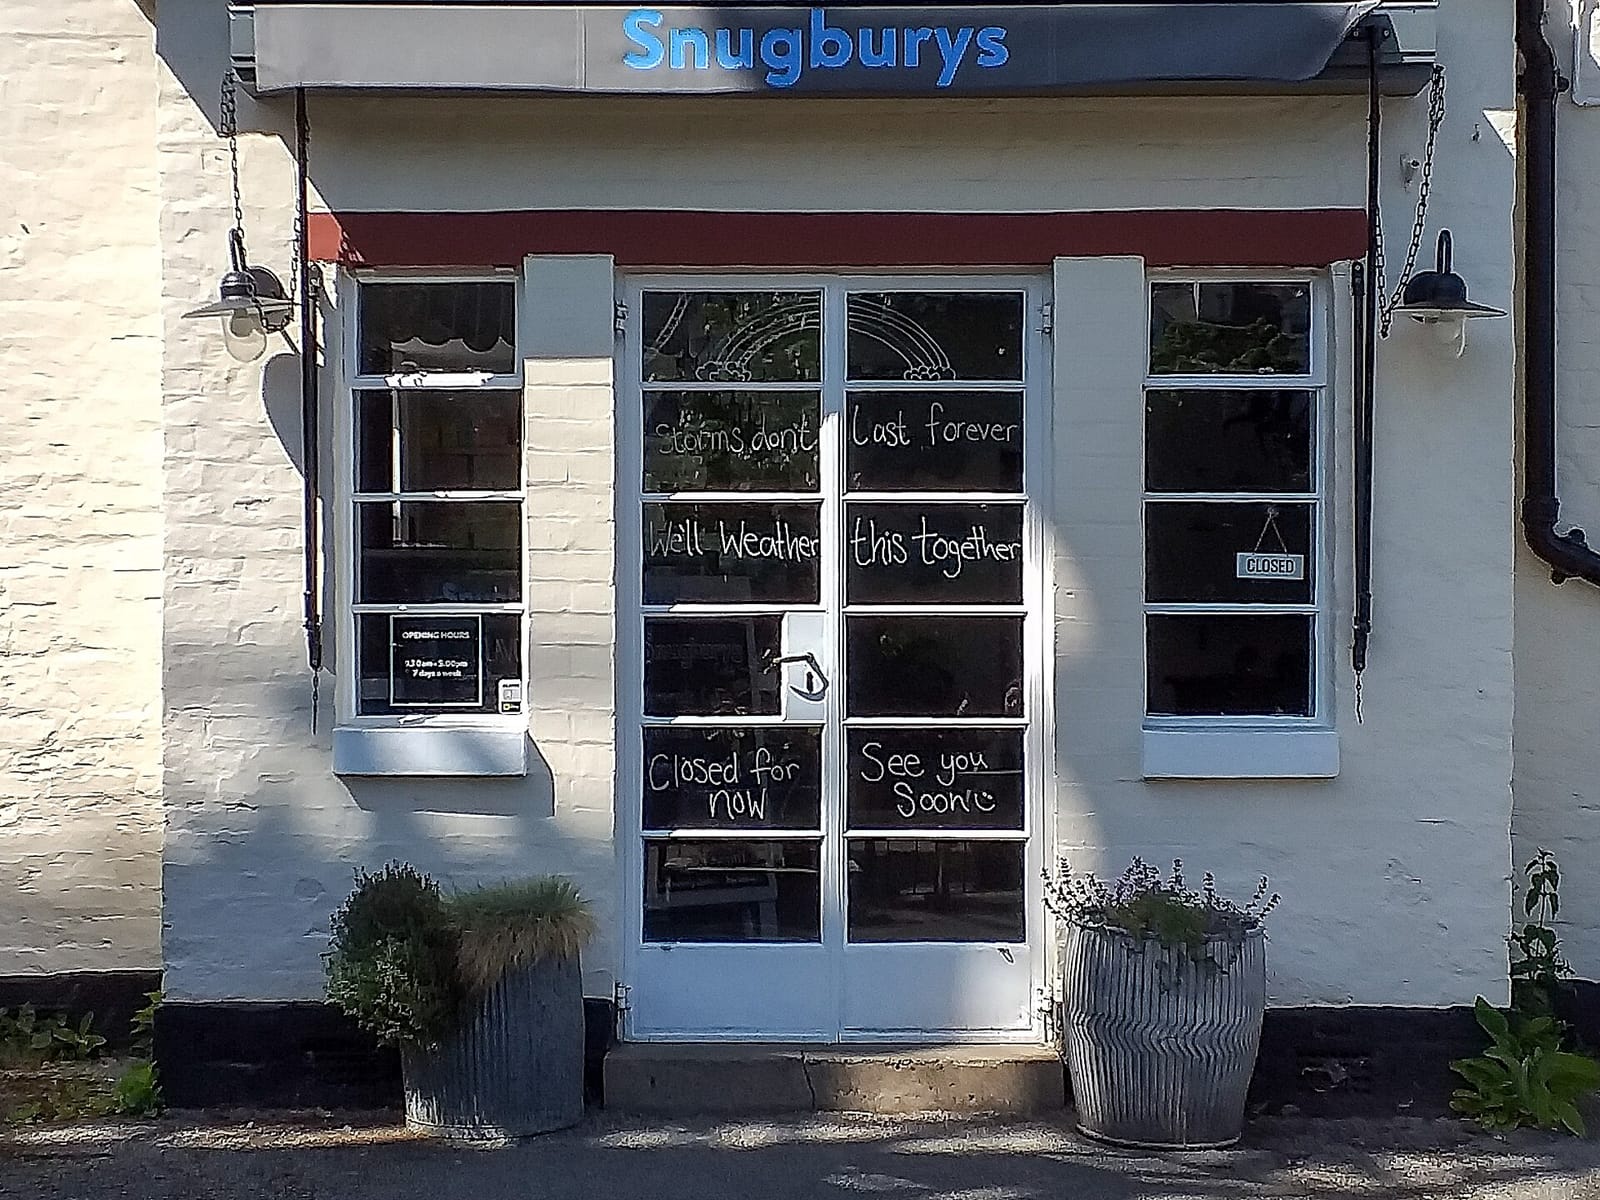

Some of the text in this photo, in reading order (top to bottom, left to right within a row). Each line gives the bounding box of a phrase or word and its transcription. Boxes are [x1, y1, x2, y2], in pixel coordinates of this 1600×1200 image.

[622, 8, 1010, 88] Snugburys
[655, 411, 819, 454] Storms don't
[925, 401, 1017, 446] forever
[649, 519, 820, 562] We'll Weather
[849, 516, 1022, 579] this together
[1247, 558, 1294, 573] CLOSED
[402, 631, 470, 639] OPENING HOURS
[412, 669, 419, 678] 7
[419, 669, 436, 679] days
[442, 669, 462, 677] week
[649, 747, 800, 790] Closed for
[860, 742, 989, 786] See you
